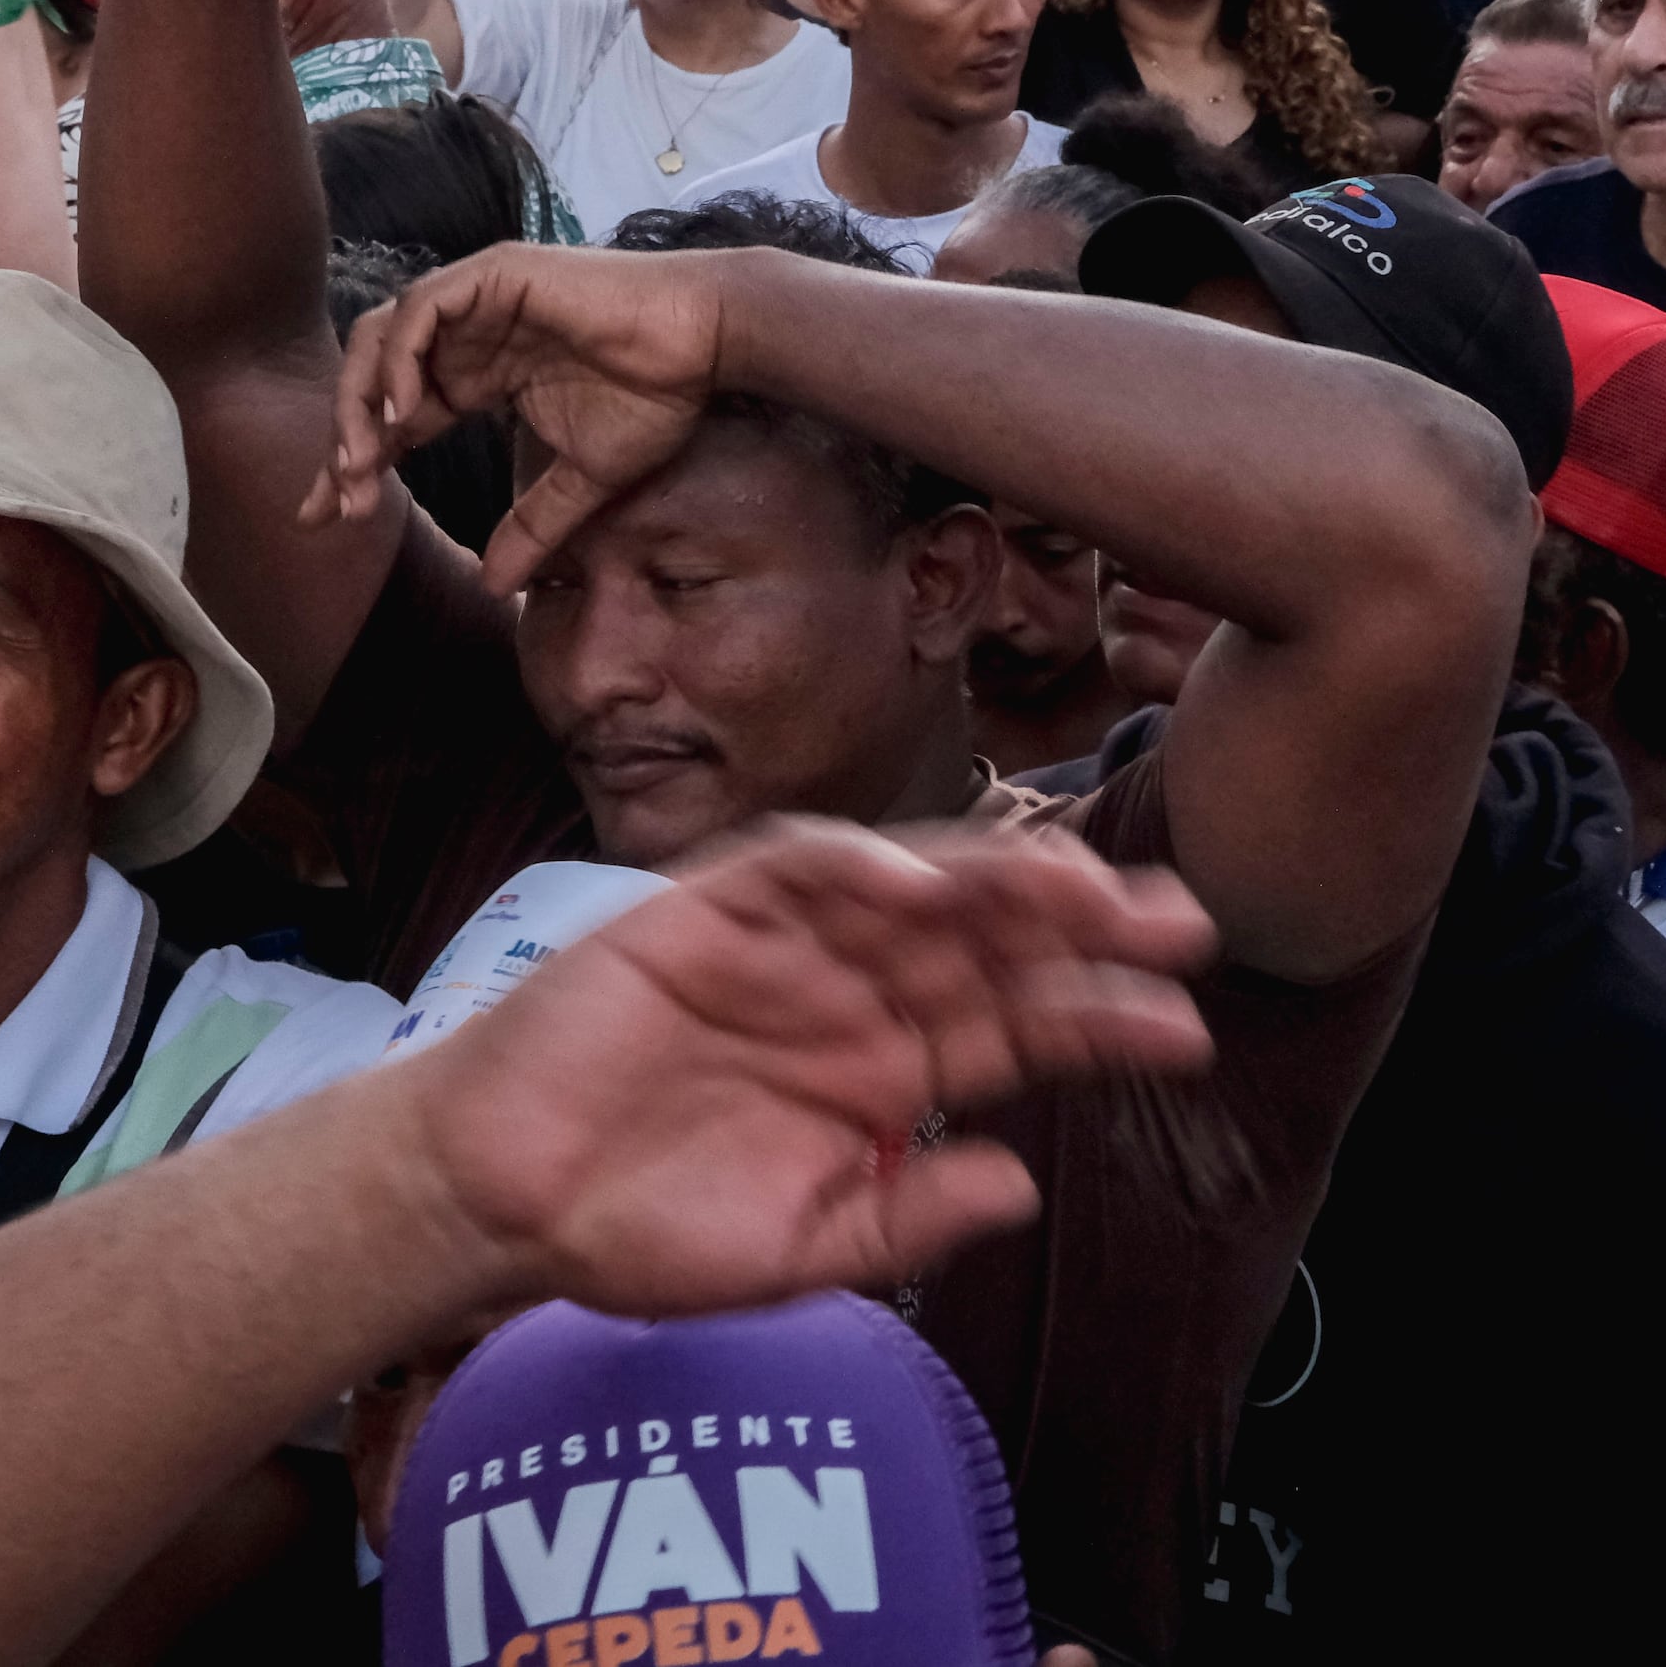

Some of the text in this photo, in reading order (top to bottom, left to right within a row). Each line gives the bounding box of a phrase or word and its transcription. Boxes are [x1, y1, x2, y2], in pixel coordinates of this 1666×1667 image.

[447, 1415, 856, 1504] PRESIDENTE
[443, 1453, 880, 1667] IVÁN
[498, 1597, 823, 1667] CEPEDA
